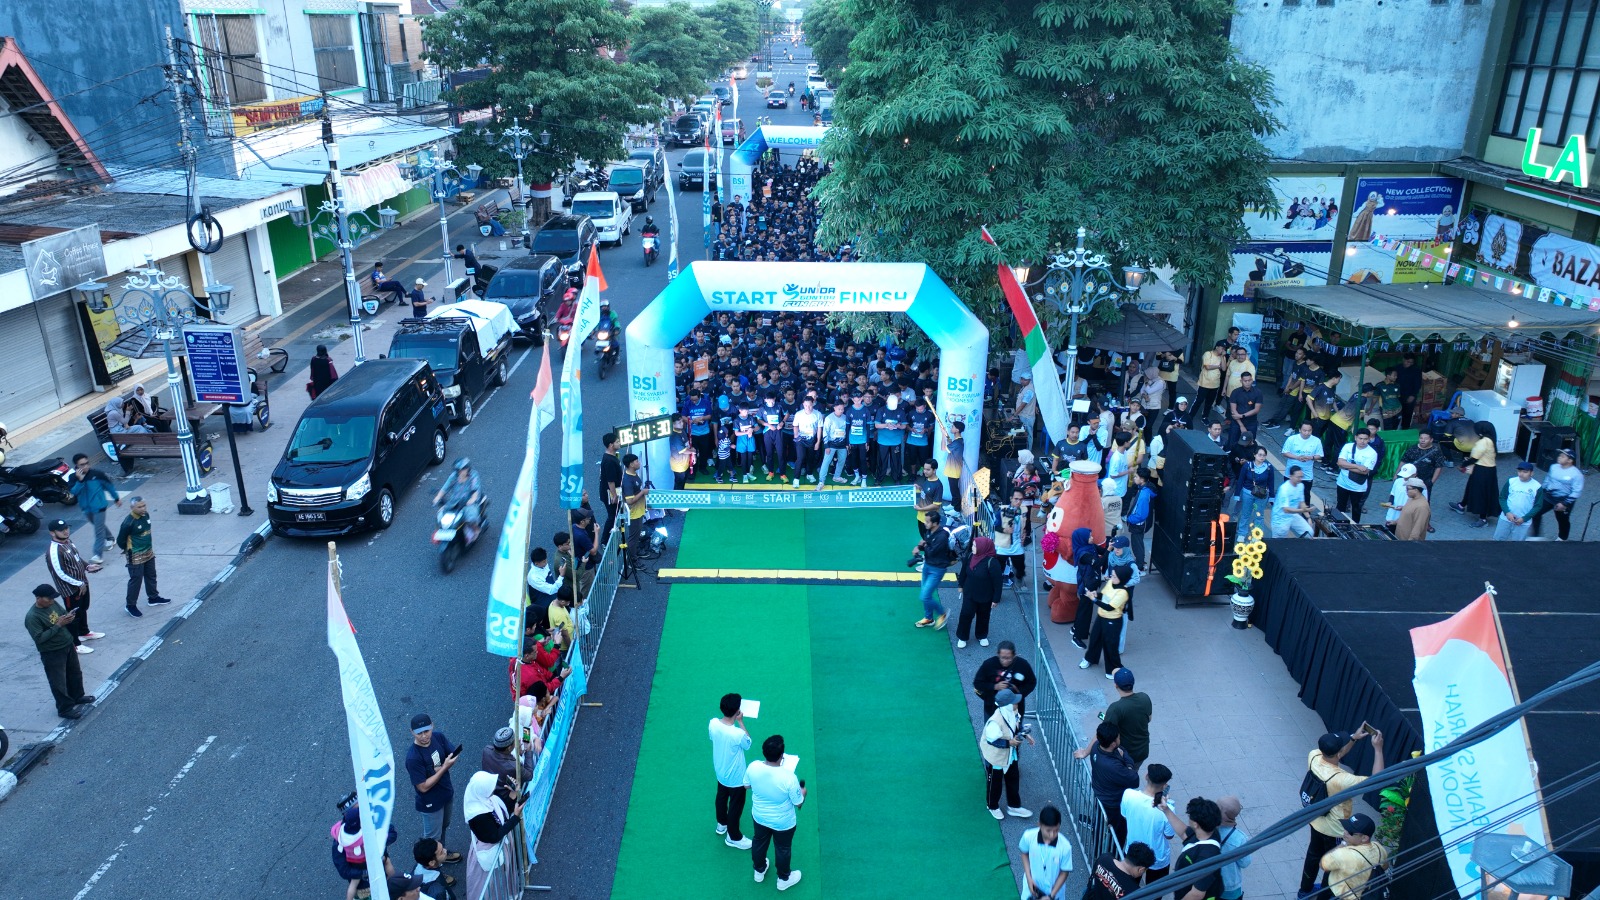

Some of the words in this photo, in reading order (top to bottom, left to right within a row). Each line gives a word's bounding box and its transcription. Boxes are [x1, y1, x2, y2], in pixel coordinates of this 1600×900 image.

[768, 137, 812, 145] WELCOME
[1521, 127, 1588, 188] LA
[732, 177, 745, 185] BSI
[1385, 188, 1404, 196] NEW
[1405, 186, 1453, 195] COLLECTION
[800, 286, 836, 294] UNIDA
[711, 291, 778, 305] START
[840, 291, 908, 305] FINISH
[632, 375, 657, 391] BSI
[947, 377, 973, 392] BSI
[763, 493, 797, 503] START
